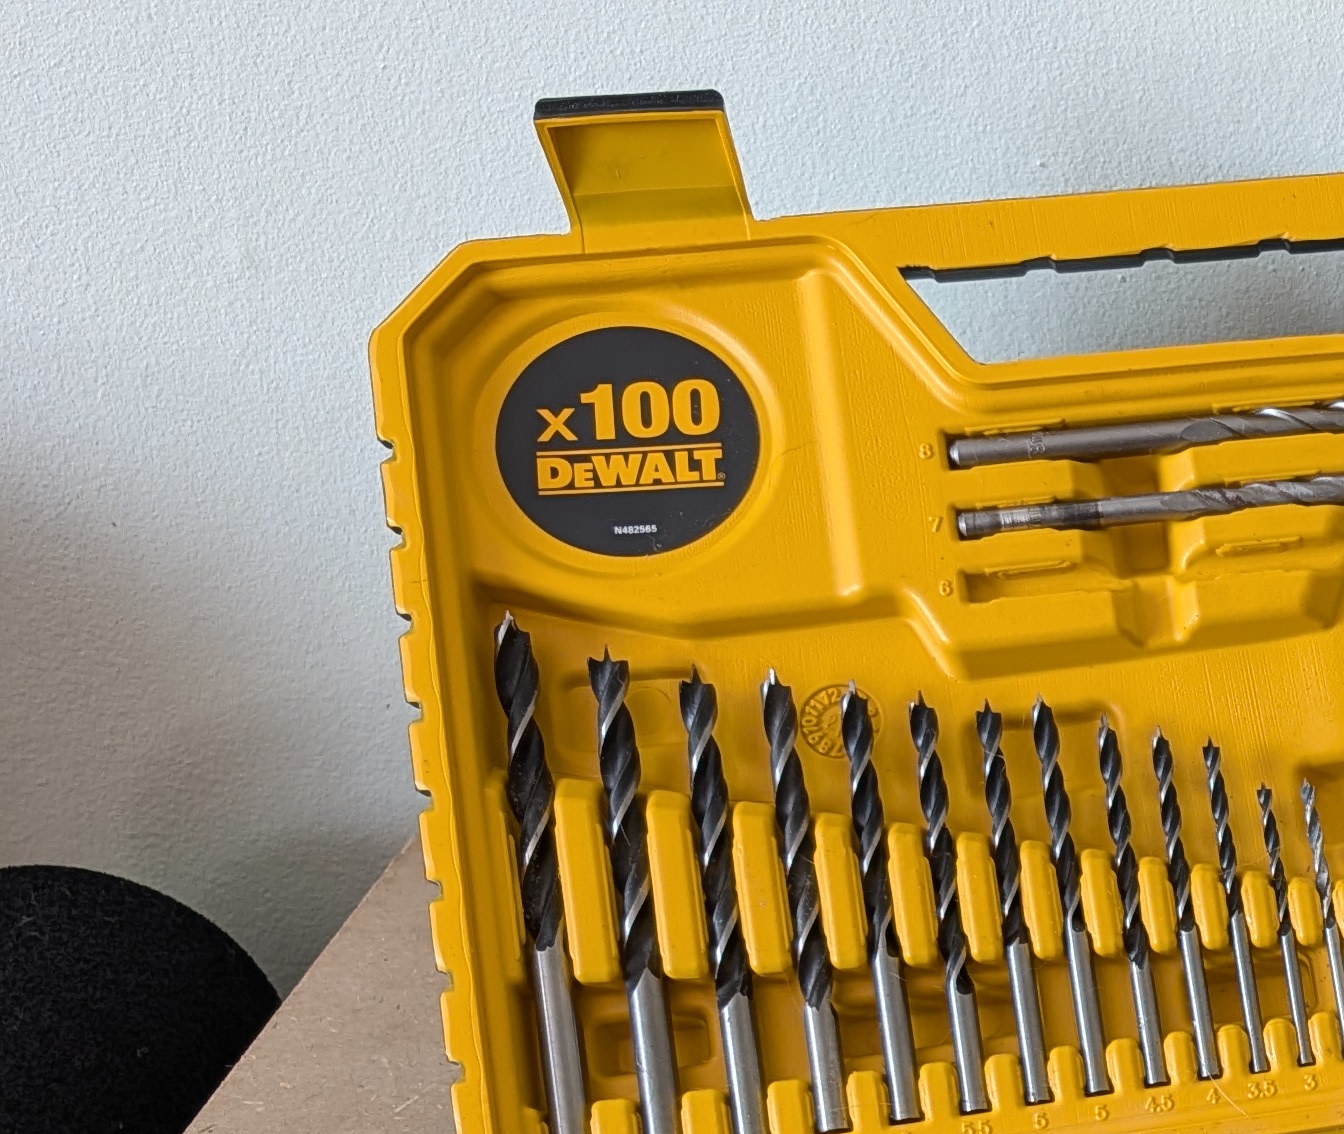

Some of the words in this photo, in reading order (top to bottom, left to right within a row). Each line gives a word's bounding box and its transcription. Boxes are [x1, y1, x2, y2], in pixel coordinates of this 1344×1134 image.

[536, 379, 720, 442] x100
[536, 450, 722, 489] DEWALT
[919, 443, 932, 459] 8
[939, 580, 952, 596] 6
[1095, 1104, 1109, 1121] 5
[1145, 1094, 1174, 1112] 4.5
[1206, 1087, 1220, 1103] 4
[1248, 1080, 1277, 1098] 3.5
[1304, 1074, 1318, 1090] 3
